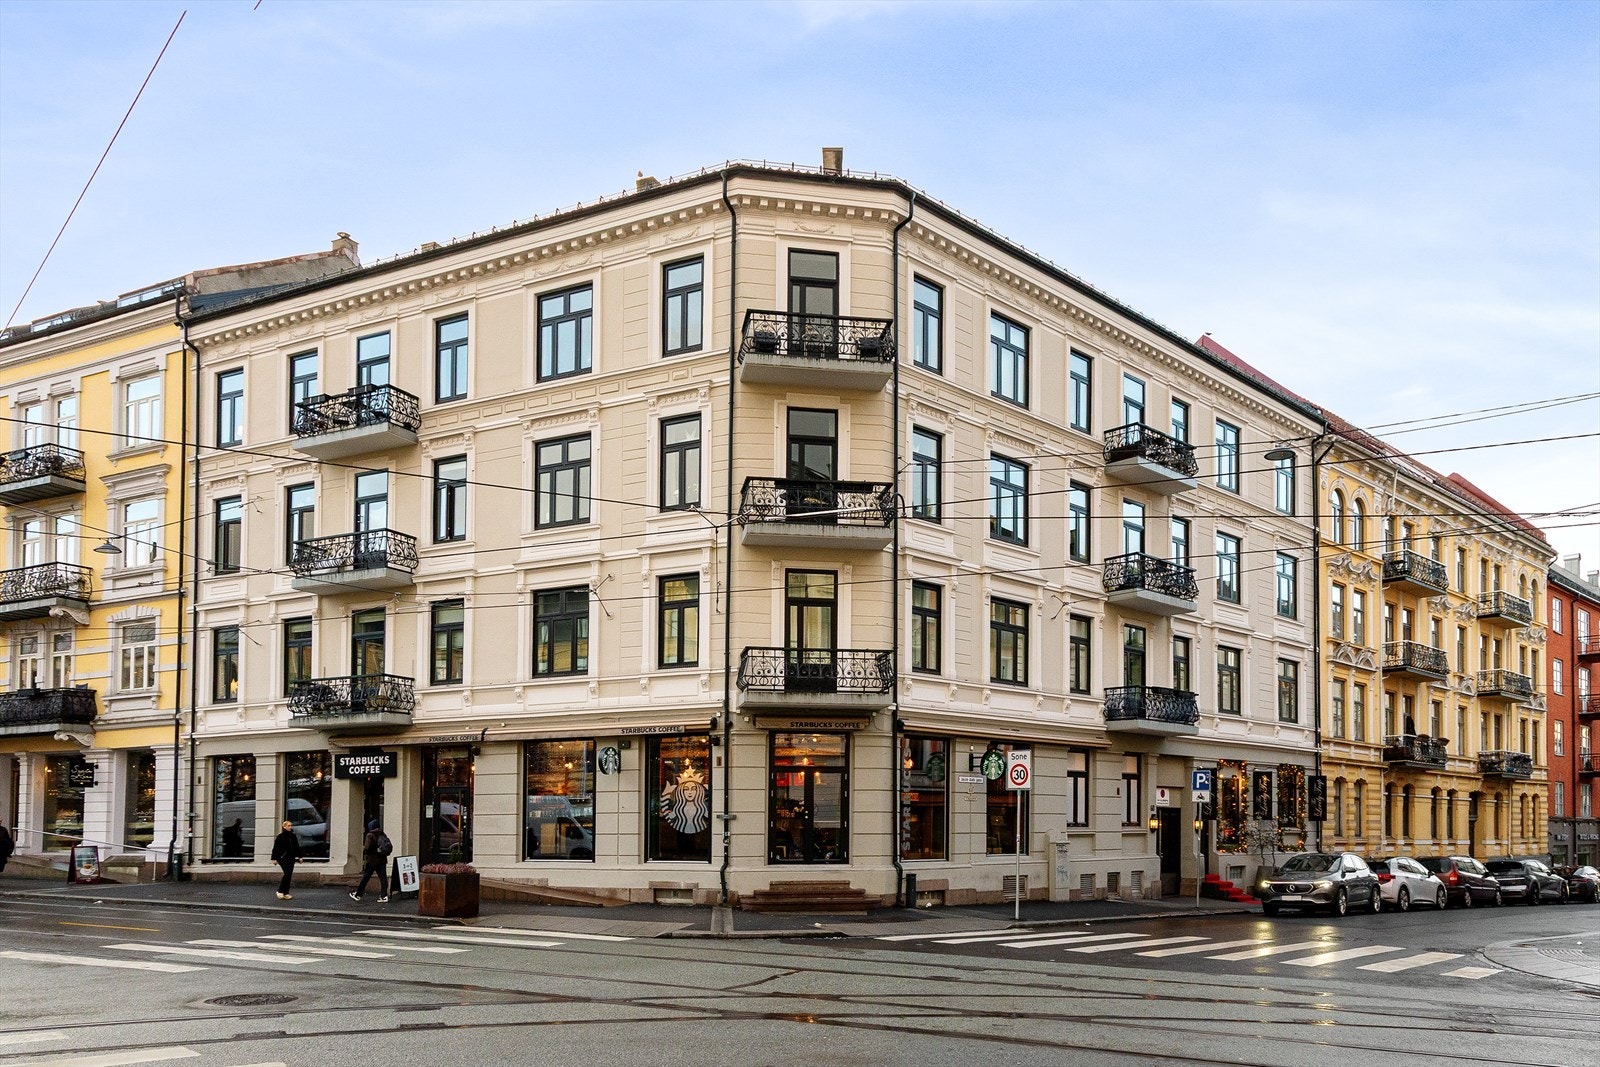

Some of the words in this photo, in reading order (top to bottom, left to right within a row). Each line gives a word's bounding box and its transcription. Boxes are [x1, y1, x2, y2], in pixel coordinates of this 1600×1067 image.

[621, 726, 656, 734] STARBUCKS
[340, 755, 390, 766] STARBUCKS
[1011, 752, 1027, 760] Sone
[349, 765, 380, 774] COFFEE
[1013, 769, 1026, 780] 30
[1196, 773, 1206, 789] P
[902, 746, 912, 851] STARBUCKS
